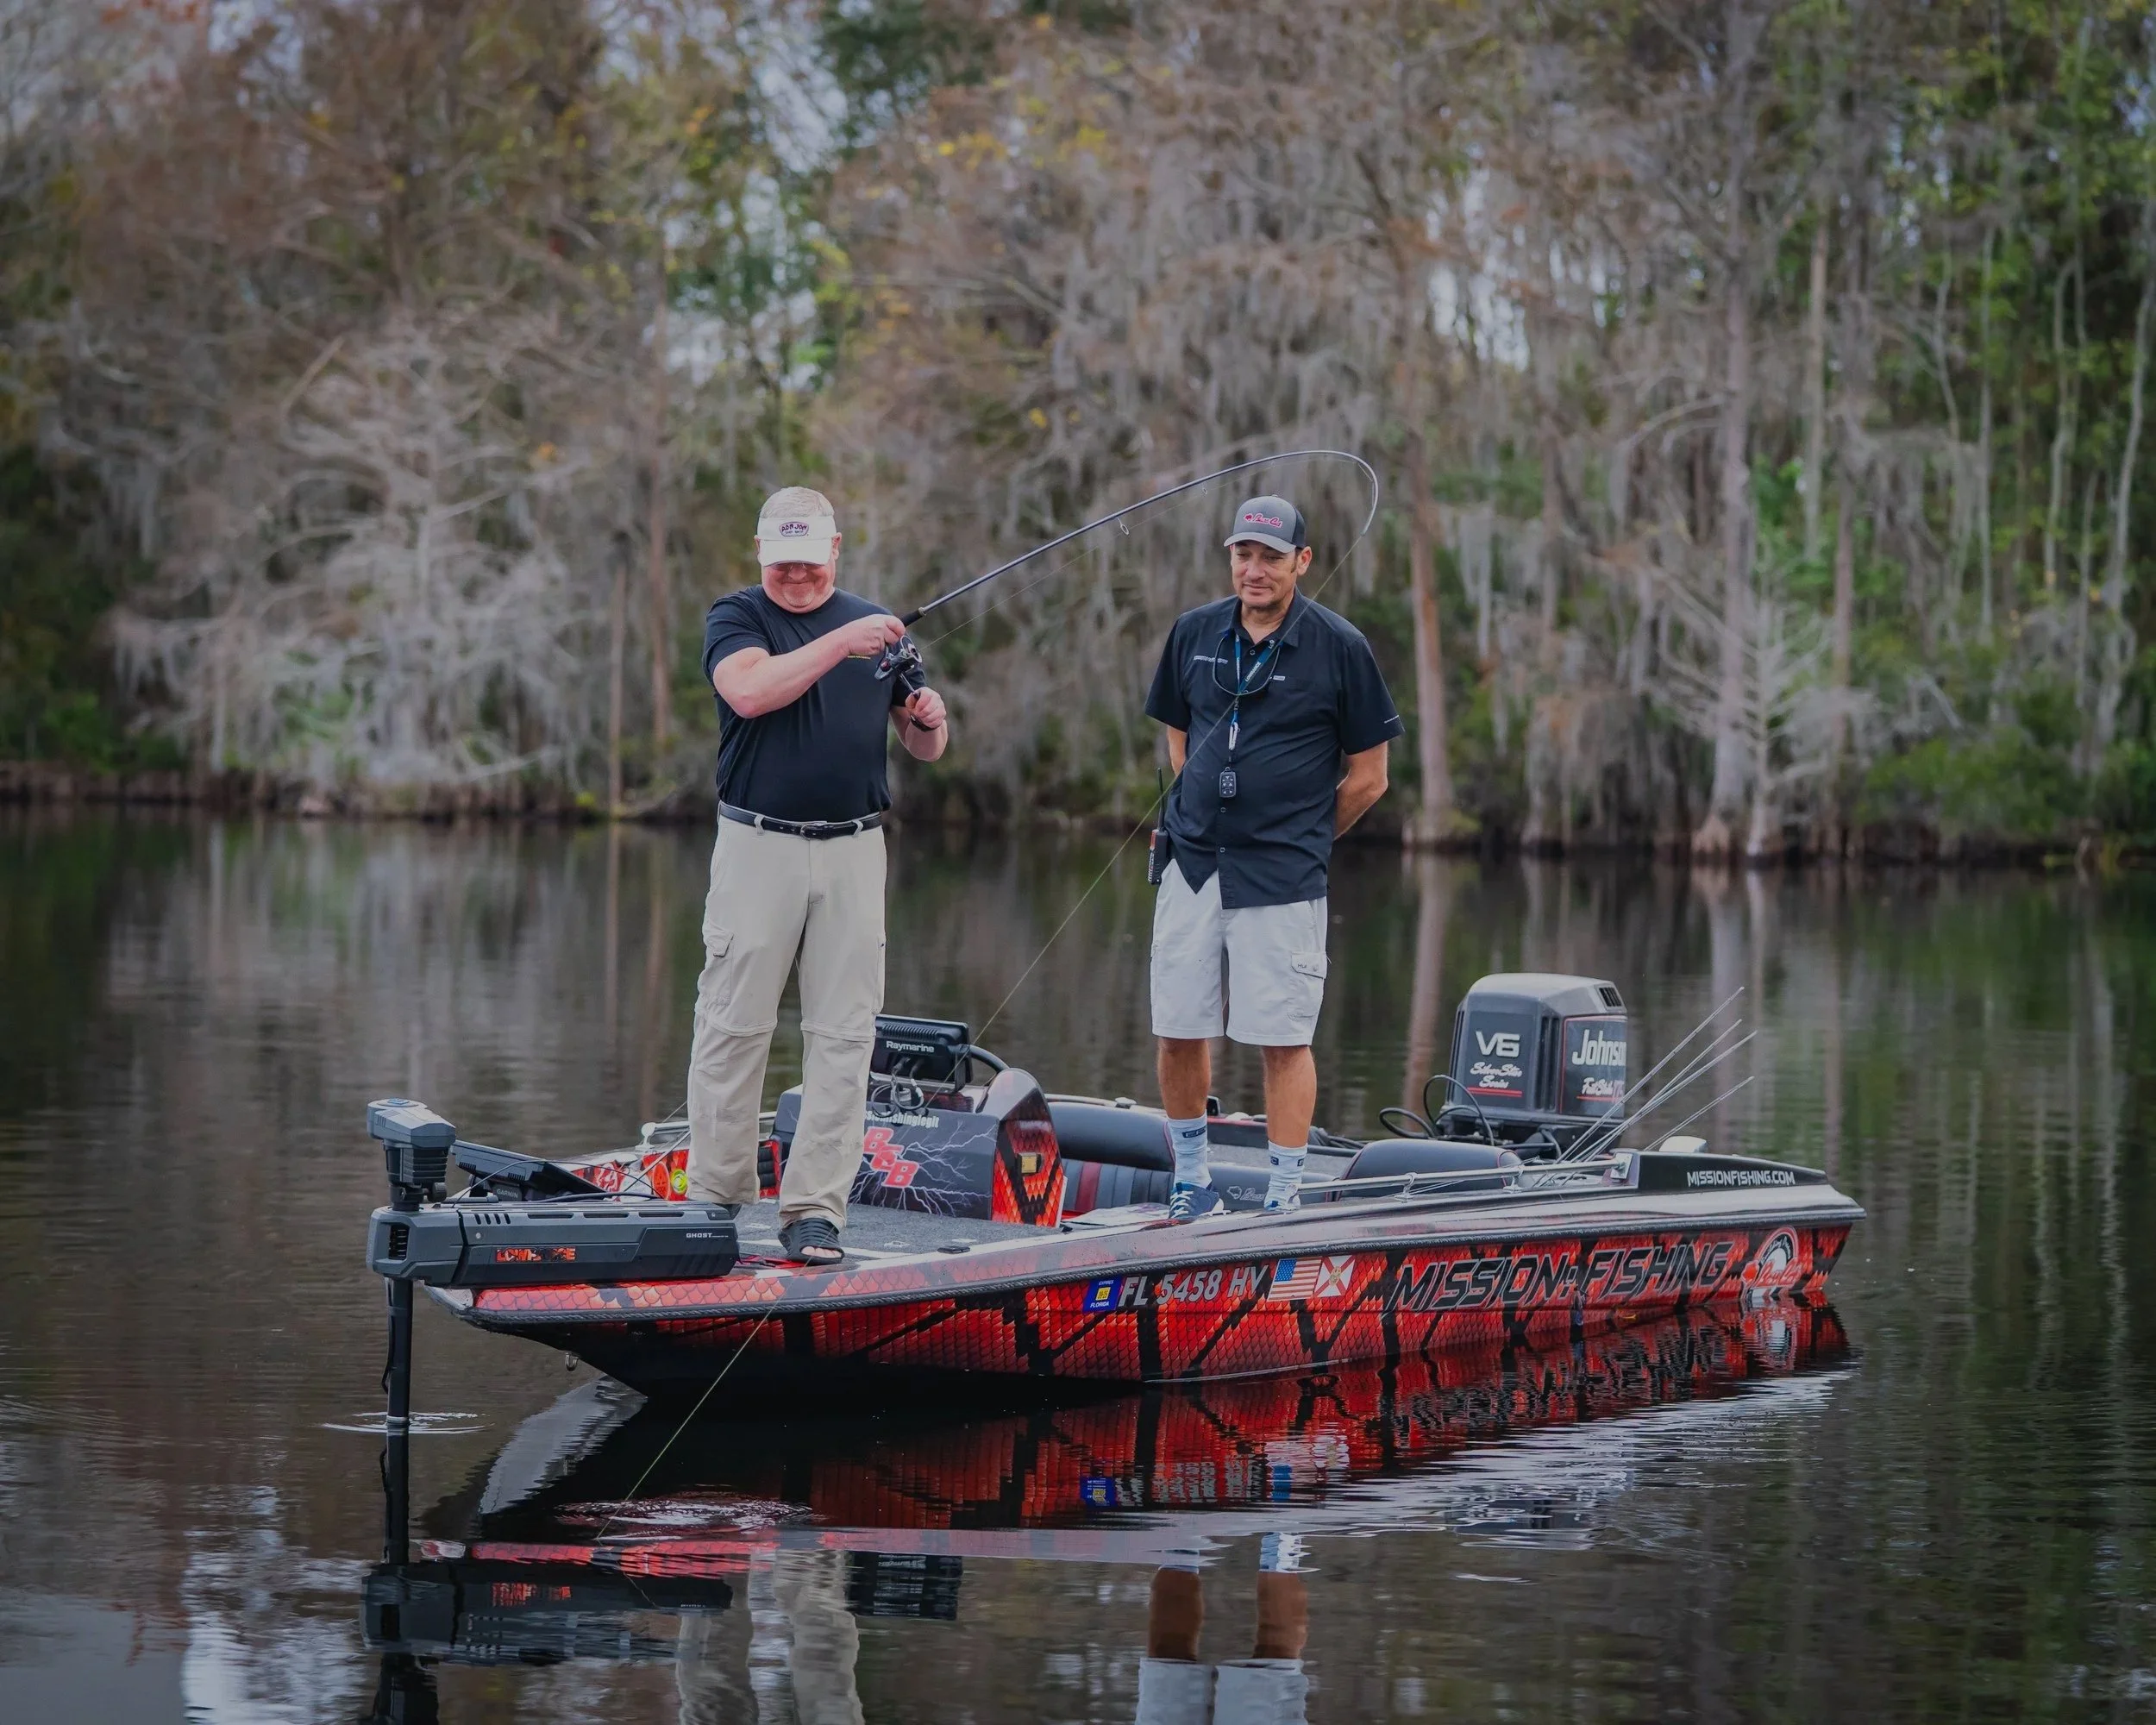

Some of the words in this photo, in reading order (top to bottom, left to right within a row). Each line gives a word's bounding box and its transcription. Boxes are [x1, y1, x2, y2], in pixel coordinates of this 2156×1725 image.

[886, 1040, 935, 1053] Raymarine
[1476, 1031, 1520, 1058] V6
[1571, 1029, 1627, 1066] Johnso
[1687, 1170, 1796, 1187] MISSIONFISHING.COM
[496, 1189, 518, 1199] GARMIN
[1579, 1241, 1734, 1303] FISHING
[1118, 1276, 1149, 1308] FL
[1156, 1269, 1223, 1305] 5458
[1227, 1264, 1269, 1298] HV
